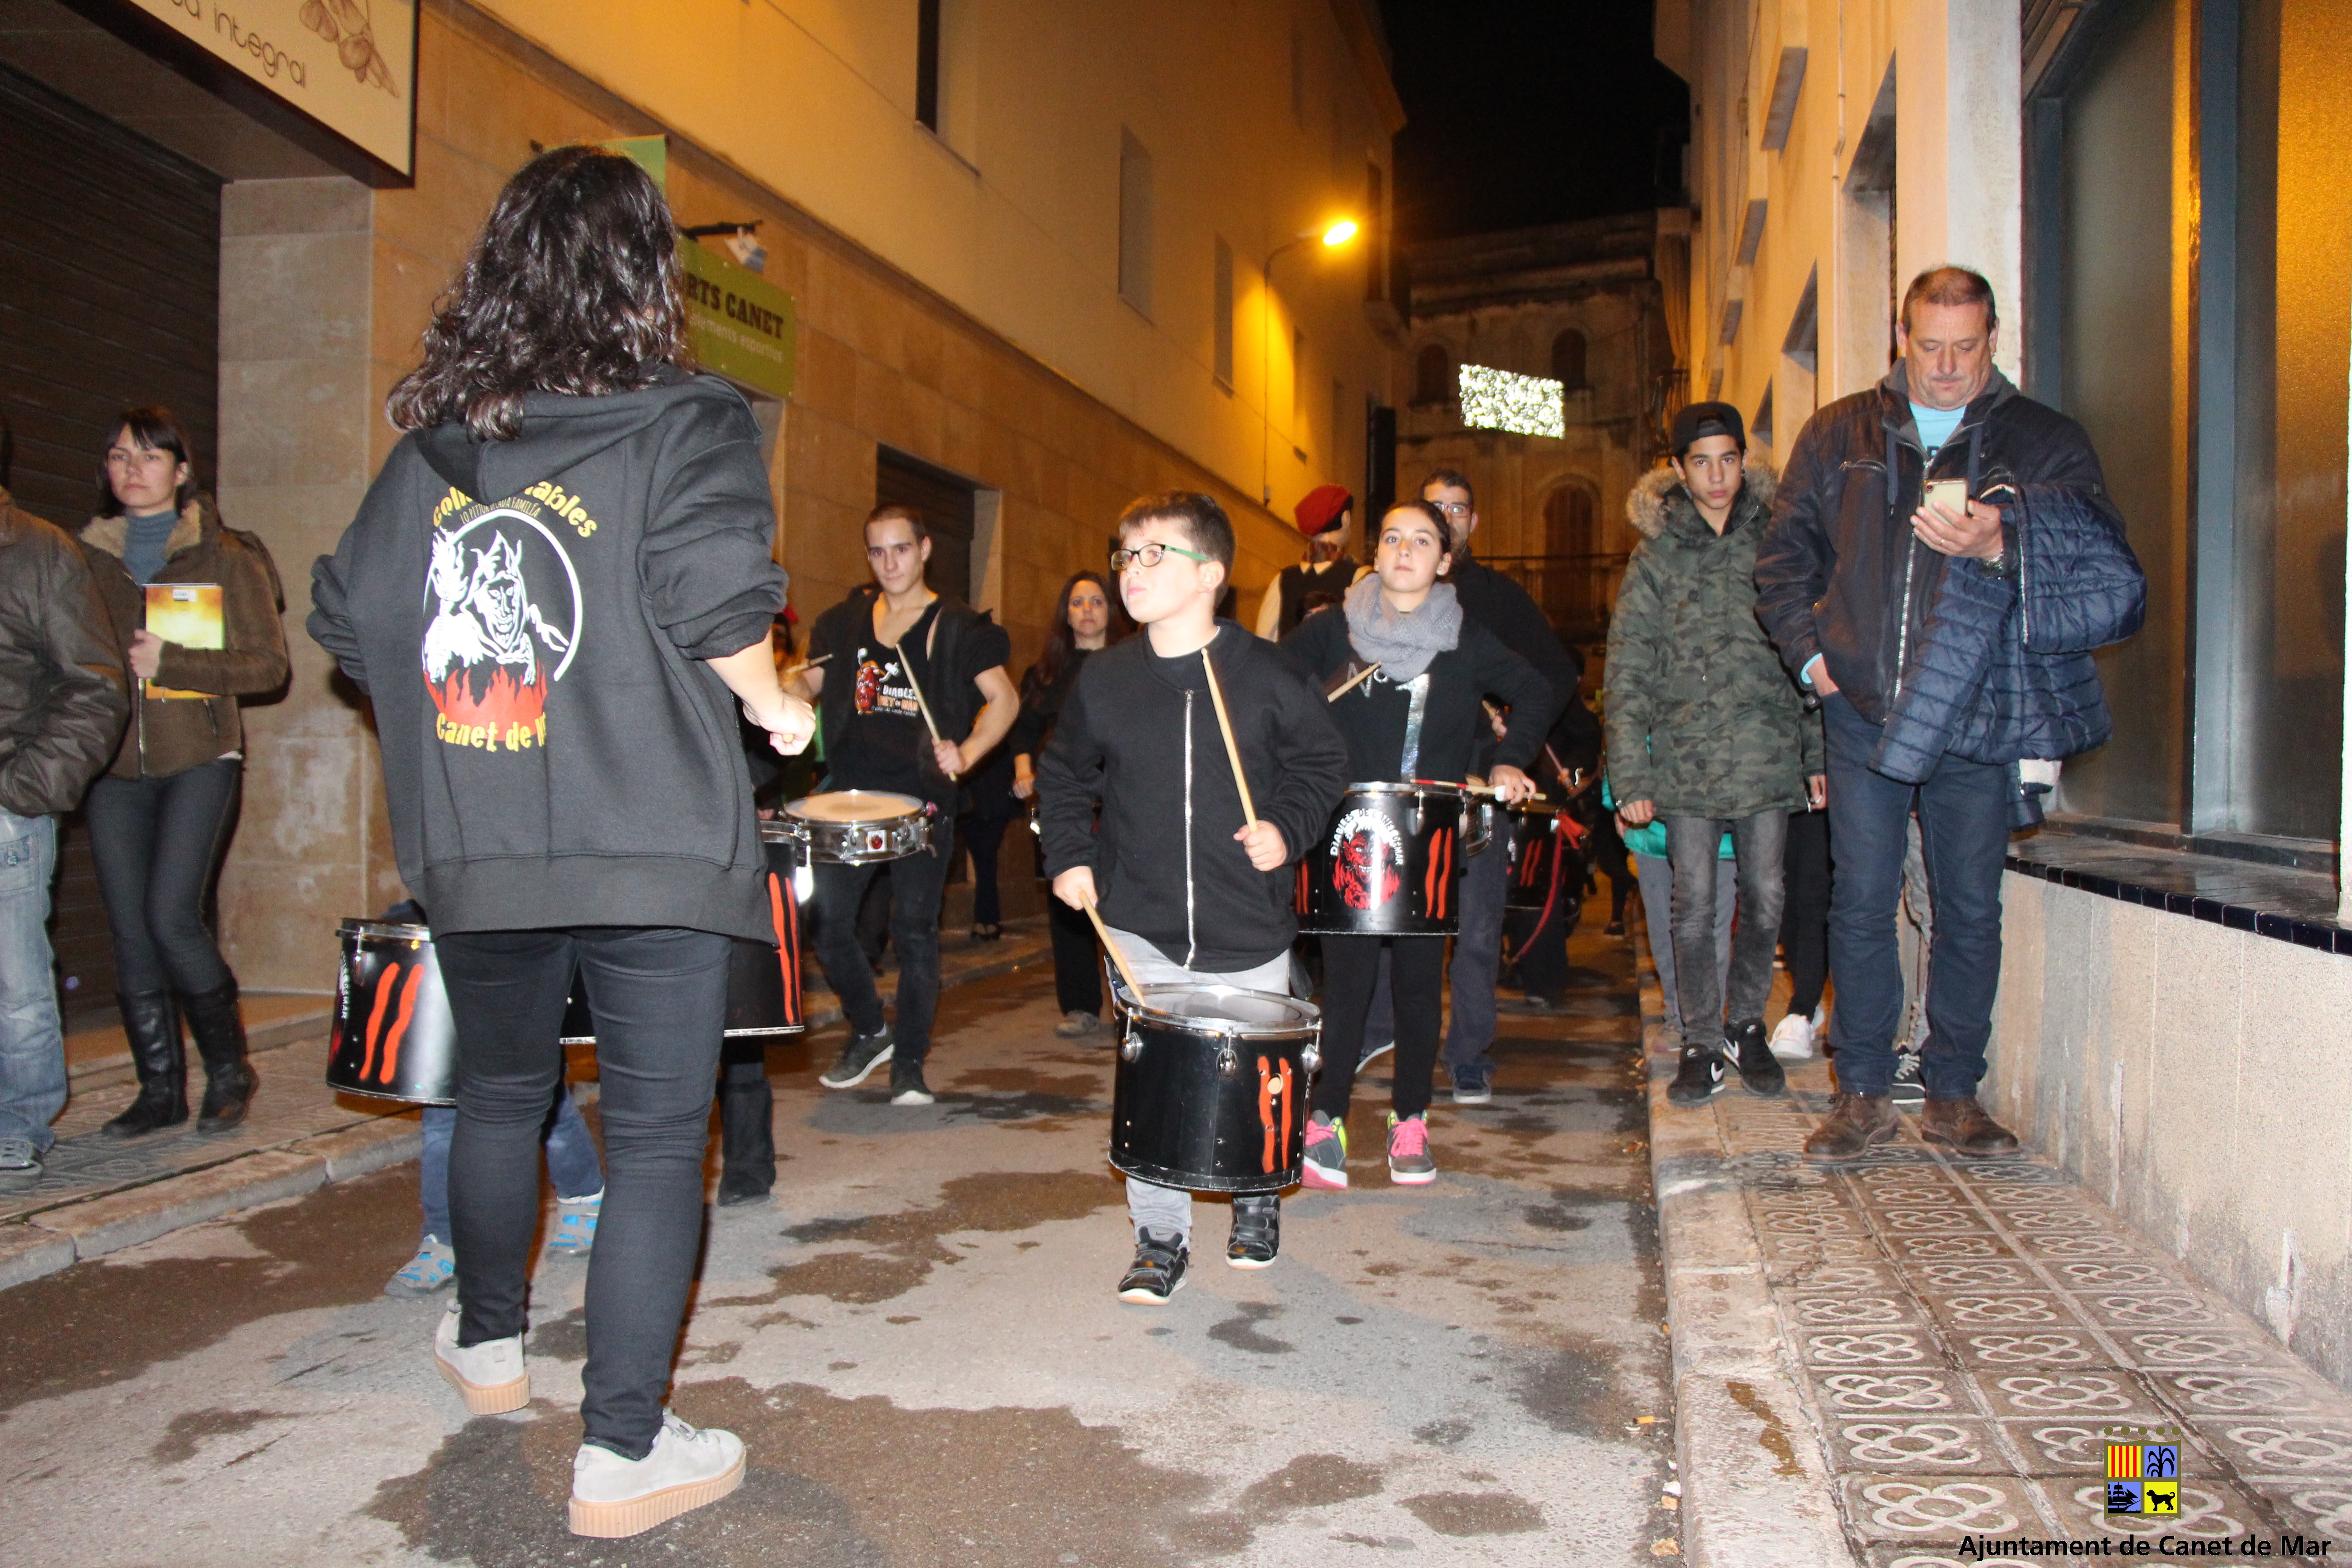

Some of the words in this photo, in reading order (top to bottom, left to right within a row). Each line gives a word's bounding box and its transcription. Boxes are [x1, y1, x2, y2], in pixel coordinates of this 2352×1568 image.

[214, 2, 306, 88] integral
[686, 272, 720, 311] RTS
[726, 292, 784, 339] CANET
[524, 481, 598, 538] ables
[882, 684, 917, 700] DIABLE
[436, 712, 498, 753] Canet
[505, 721, 532, 752] de
[1330, 813, 1354, 857] DIABLES
[1394, 847, 1404, 865] MAR
